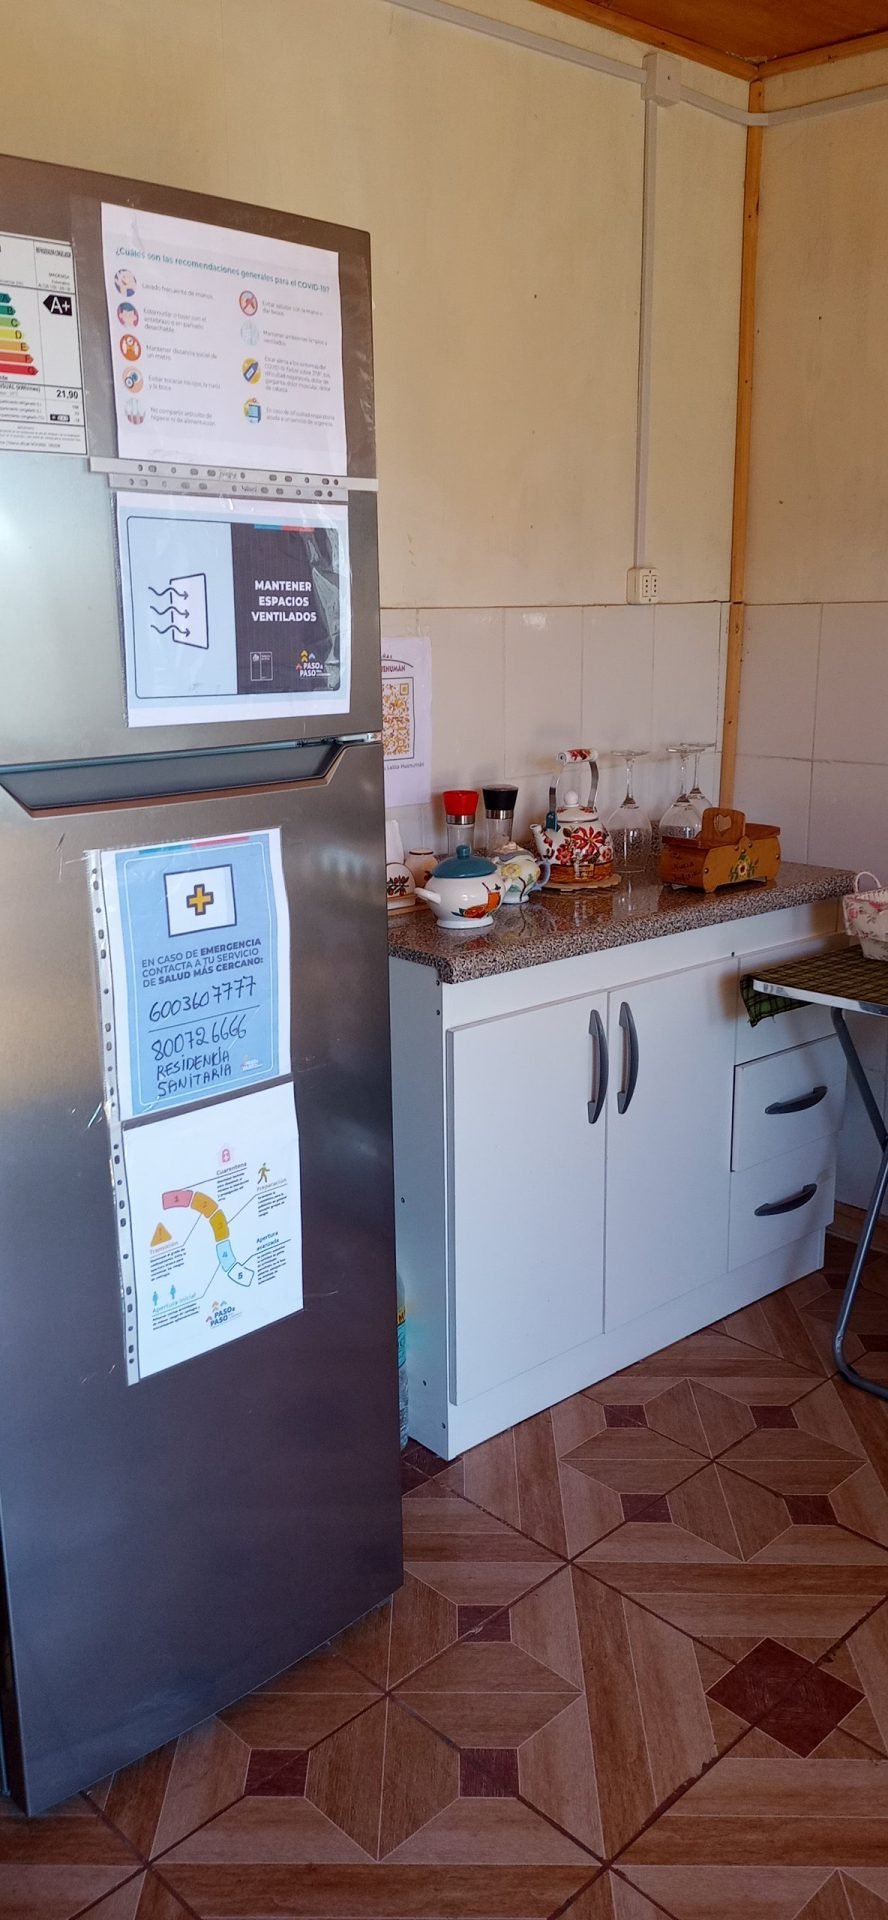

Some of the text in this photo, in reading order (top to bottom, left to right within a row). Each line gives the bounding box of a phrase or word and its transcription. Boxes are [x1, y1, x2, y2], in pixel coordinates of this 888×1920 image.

[148, 253, 161, 262] son
[163, 255, 174, 264] las
[175, 259, 240, 276] recomendaciones
[241, 270, 274, 283] generales
[275, 276, 289, 286] para
[298, 280, 330, 294] COVID-19?
[51, 296, 71, 314] A+
[11, 318, 19, 327] C
[15, 330, 22, 340] D
[21, 342, 29, 352] E
[56, 389, 79, 400] 21,90
[254, 579, 313, 592] MANTENER
[258, 595, 310, 607] ESPACIOS
[251, 610, 318, 622] VENTILADOS
[303, 662, 320, 671] PASO
[299, 669, 317, 678] PASO
[142, 938, 262, 968] EN CASO DE EMERGENCIA
[142, 947, 259, 979] CONTACTA A TU SERVICIO
[143, 957, 264, 988] DE SALUD MÁS CERCANO:
[216, 1162, 247, 1176] Cuarentena
[174, 1195, 179, 1203] 1
[256, 1231, 278, 1244] Apertura
[256, 1238, 280, 1251] avanzada
[238, 1272, 243, 1280] 5
[214, 1305, 232, 1319] PASO
[210, 1315, 229, 1328] PASO
